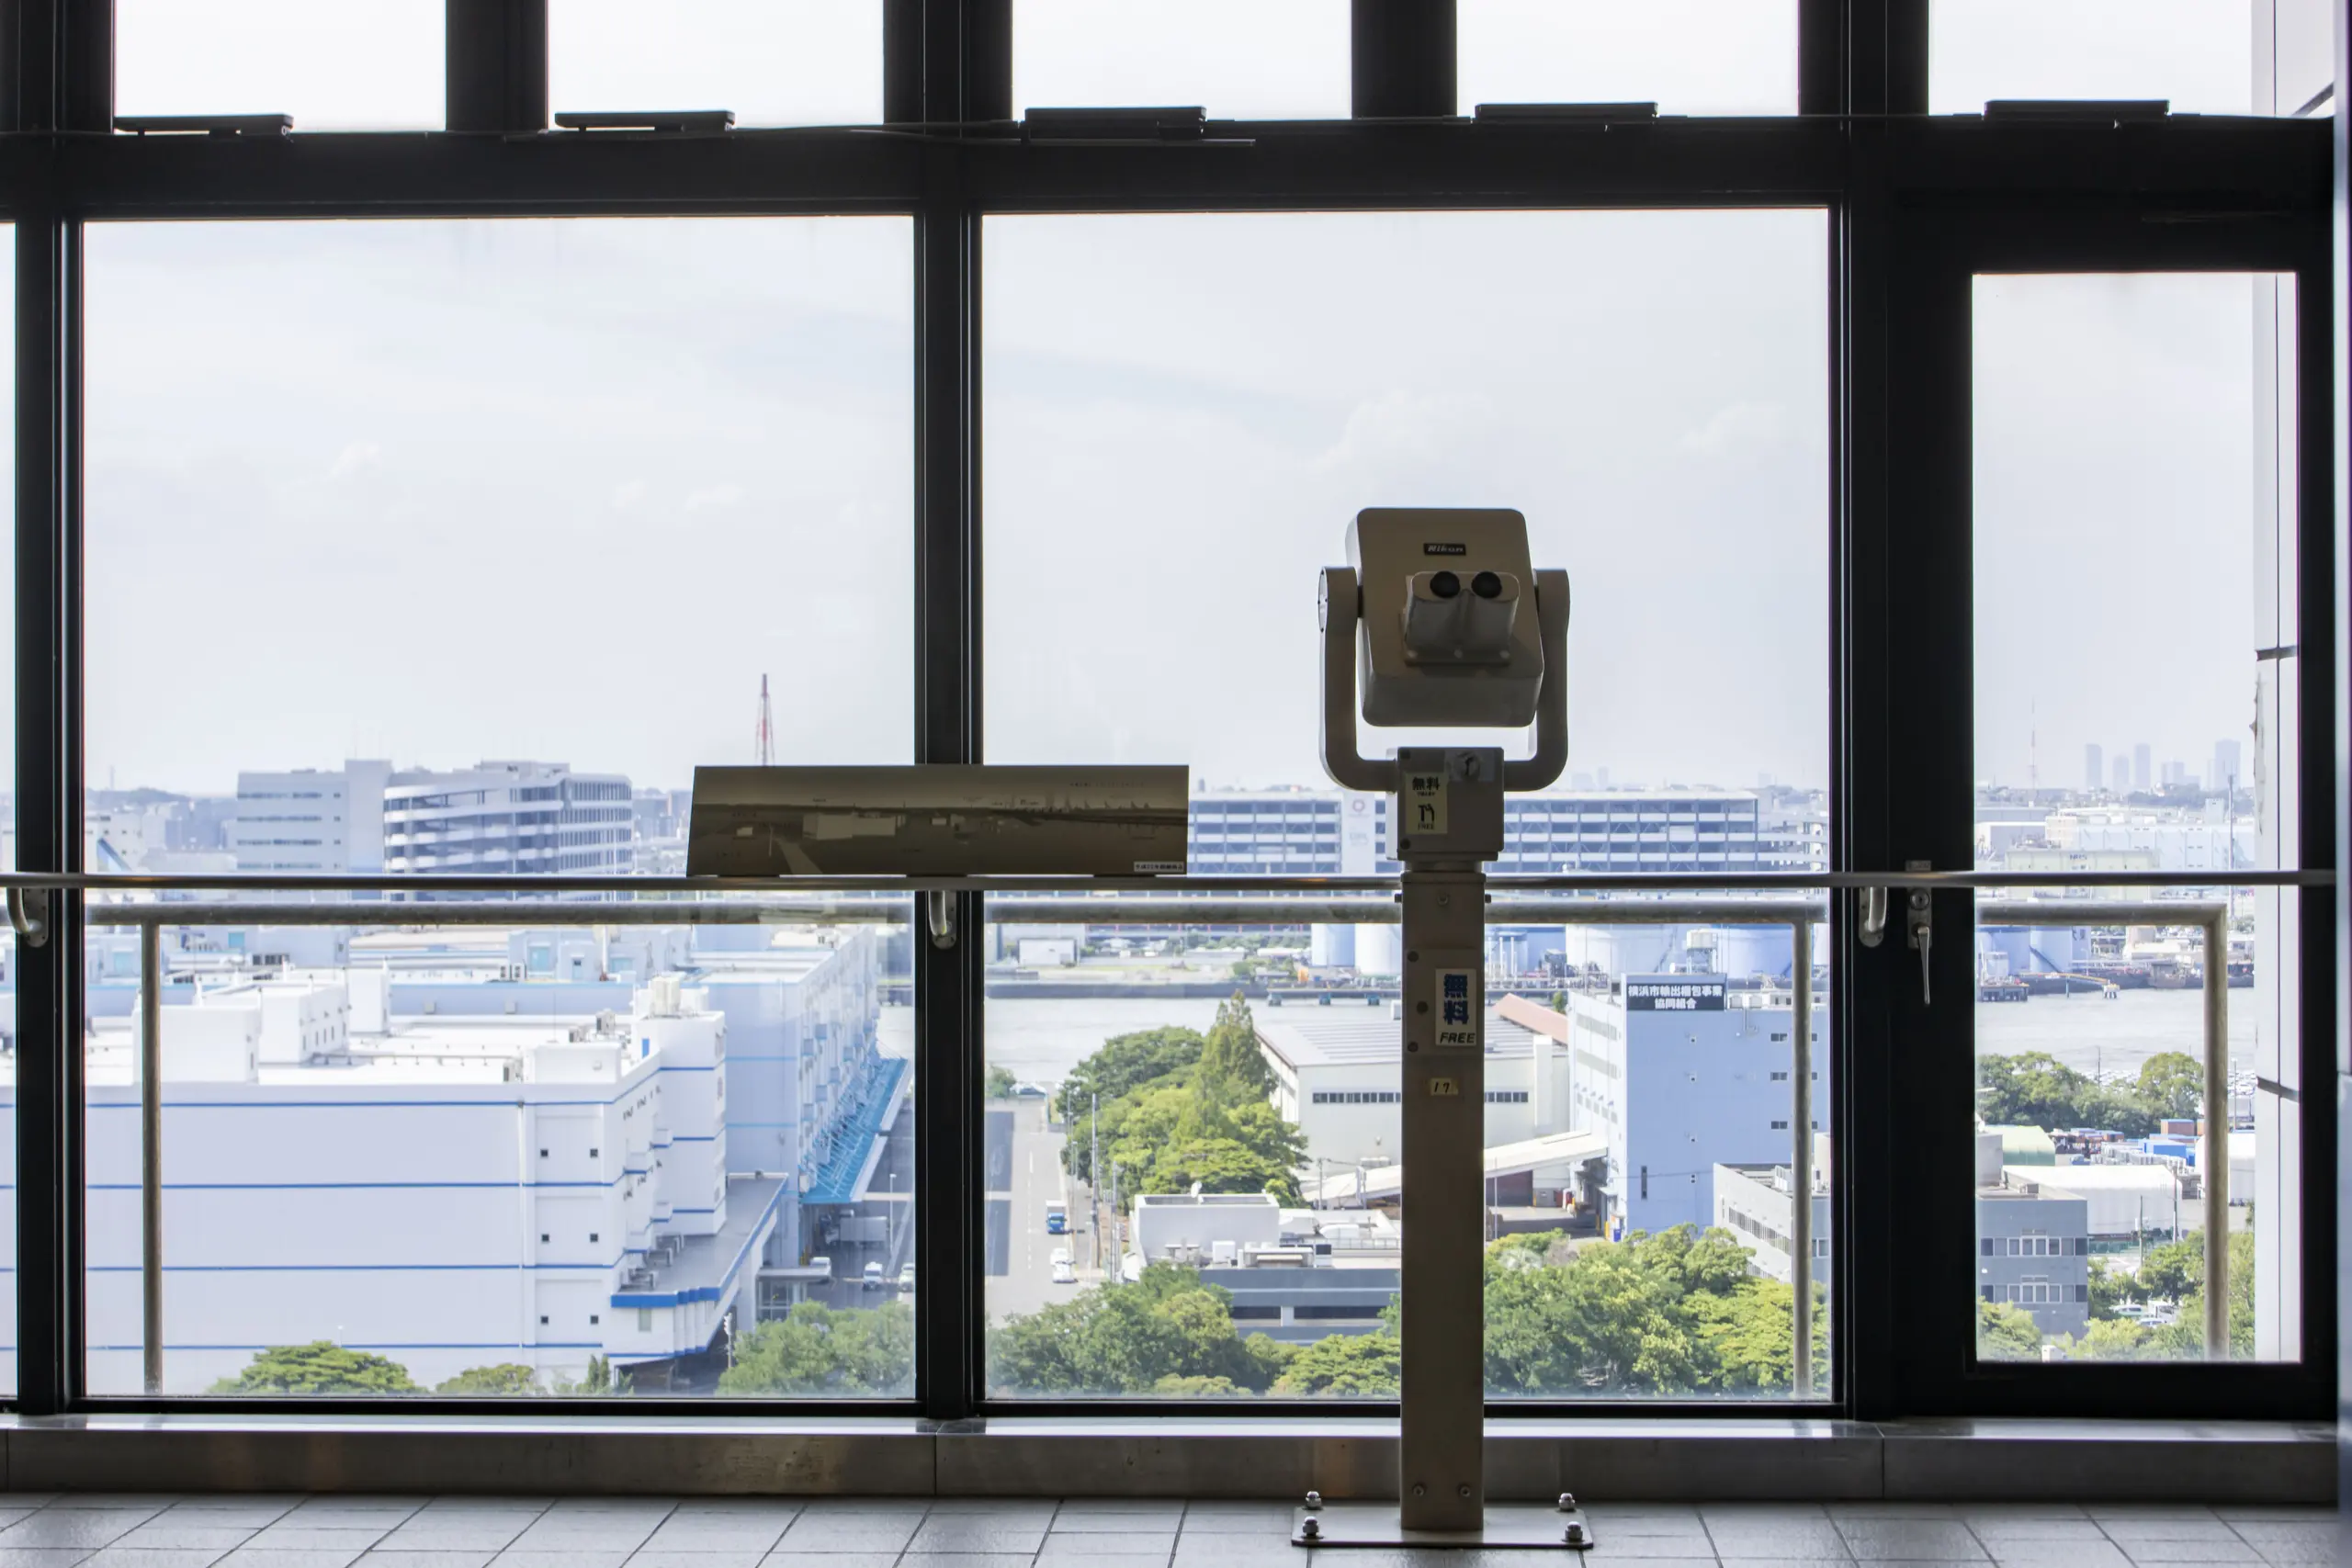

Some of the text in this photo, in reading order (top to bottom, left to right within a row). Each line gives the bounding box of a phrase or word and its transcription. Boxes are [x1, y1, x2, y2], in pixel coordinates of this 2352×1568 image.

[1412, 776, 1440, 790] 無料
[1443, 974, 1469, 1025] 無料
[1655, 998, 1697, 1009] 協同組合
[1440, 1032, 1476, 1044] FREE
[1433, 1081, 1451, 1093] 17
